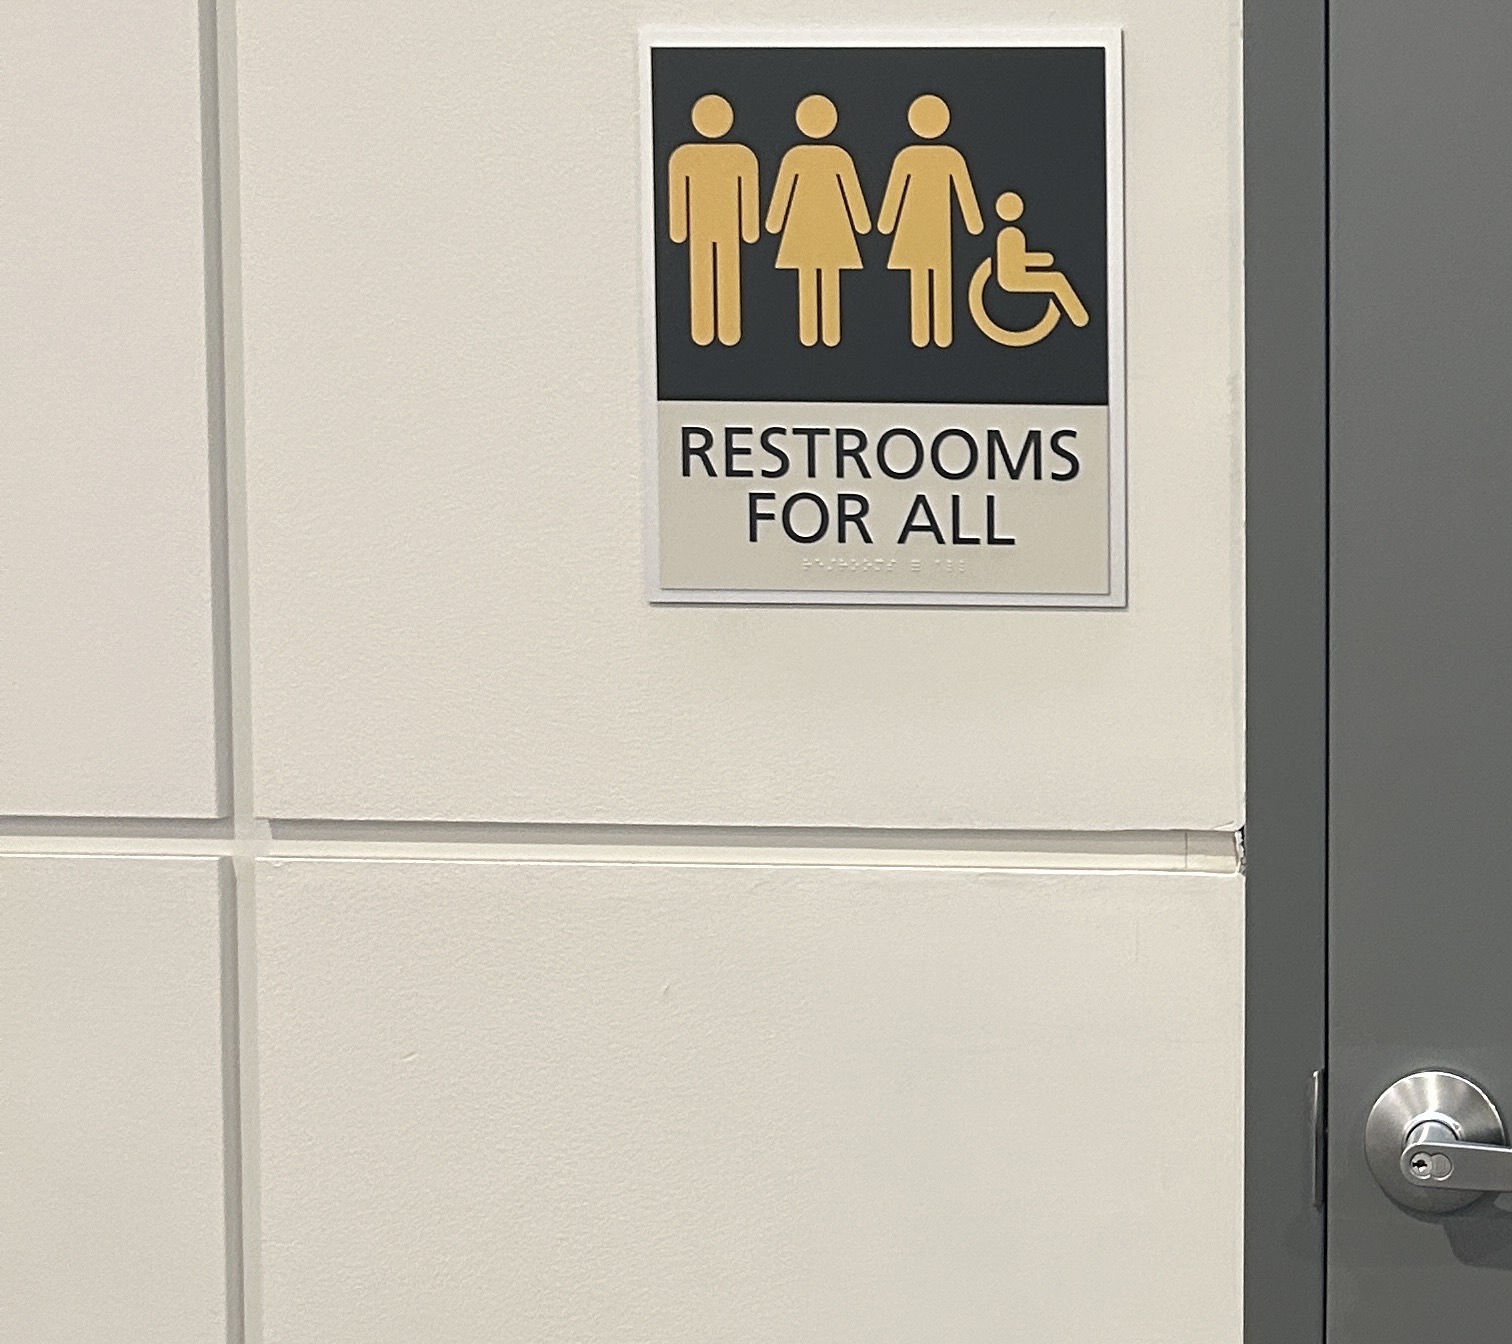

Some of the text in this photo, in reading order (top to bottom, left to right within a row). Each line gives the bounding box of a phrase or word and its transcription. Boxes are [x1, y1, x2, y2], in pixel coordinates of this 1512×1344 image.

[680, 426, 1080, 482] RESTROOMS
[748, 492, 1016, 546] FOR ALL
